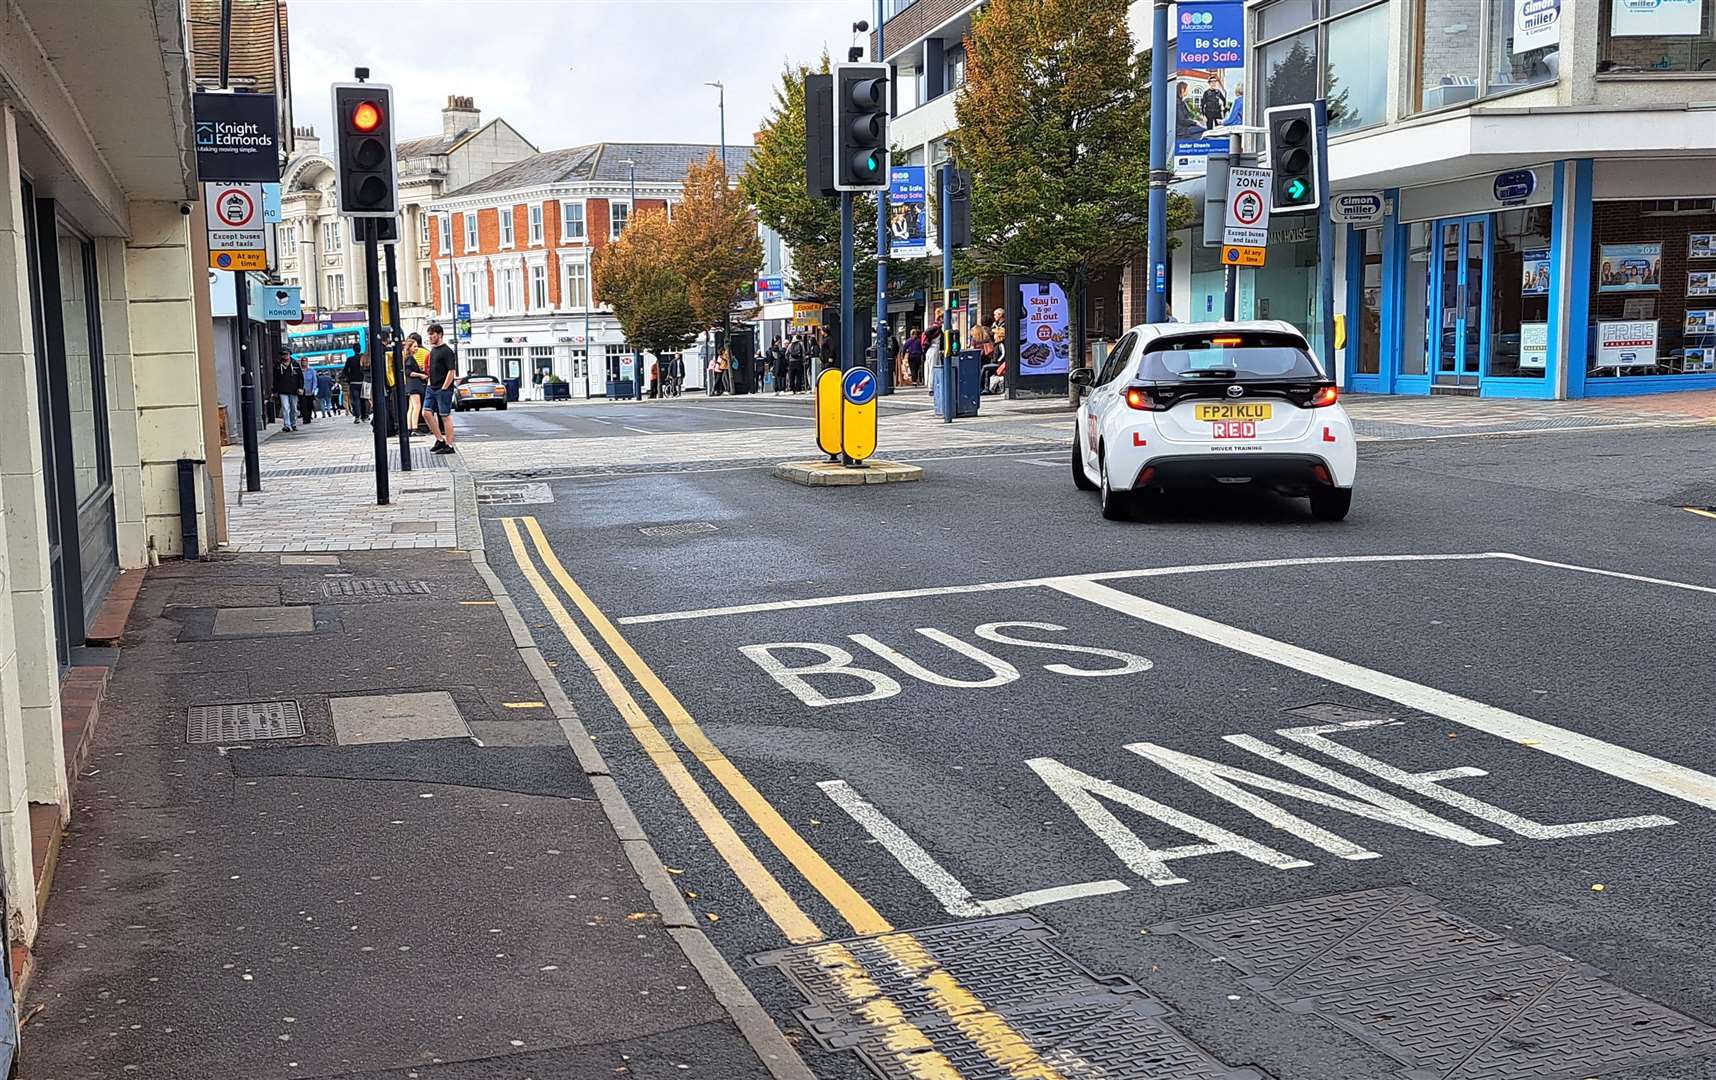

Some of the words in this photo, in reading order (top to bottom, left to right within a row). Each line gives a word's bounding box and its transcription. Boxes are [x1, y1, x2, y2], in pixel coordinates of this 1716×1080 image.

[1525, 12, 1553, 28] miller
[1195, 38, 1210, 48] Be
[1212, 37, 1241, 48] Safe.
[1180, 52, 1210, 64] Keep
[1212, 51, 1241, 62] Safe.
[215, 122, 258, 136] Knight
[216, 134, 272, 145] Edmonds
[1231, 169, 1271, 177] PEDESTRIAN
[1236, 177, 1265, 188] ZONE
[1343, 197, 1374, 205] simon
[1344, 206, 1374, 214] miller
[212, 233, 238, 241] Except
[1227, 229, 1248, 237] Except
[1641, 246, 1660, 254] 2023
[1030, 297, 1049, 306] Stay
[1050, 296, 1059, 305] in
[1031, 312, 1042, 321] all
[1043, 313, 1058, 321] out
[1603, 323, 1654, 340] FREE
[1202, 405, 1233, 419] FP21
[1236, 404, 1264, 418] KLU
[1214, 422, 1256, 438] RED
[1324, 427, 1335, 441] L
[1133, 432, 1146, 446] L
[738, 621, 1154, 708] BUS
[816, 718, 1676, 918] LANE
